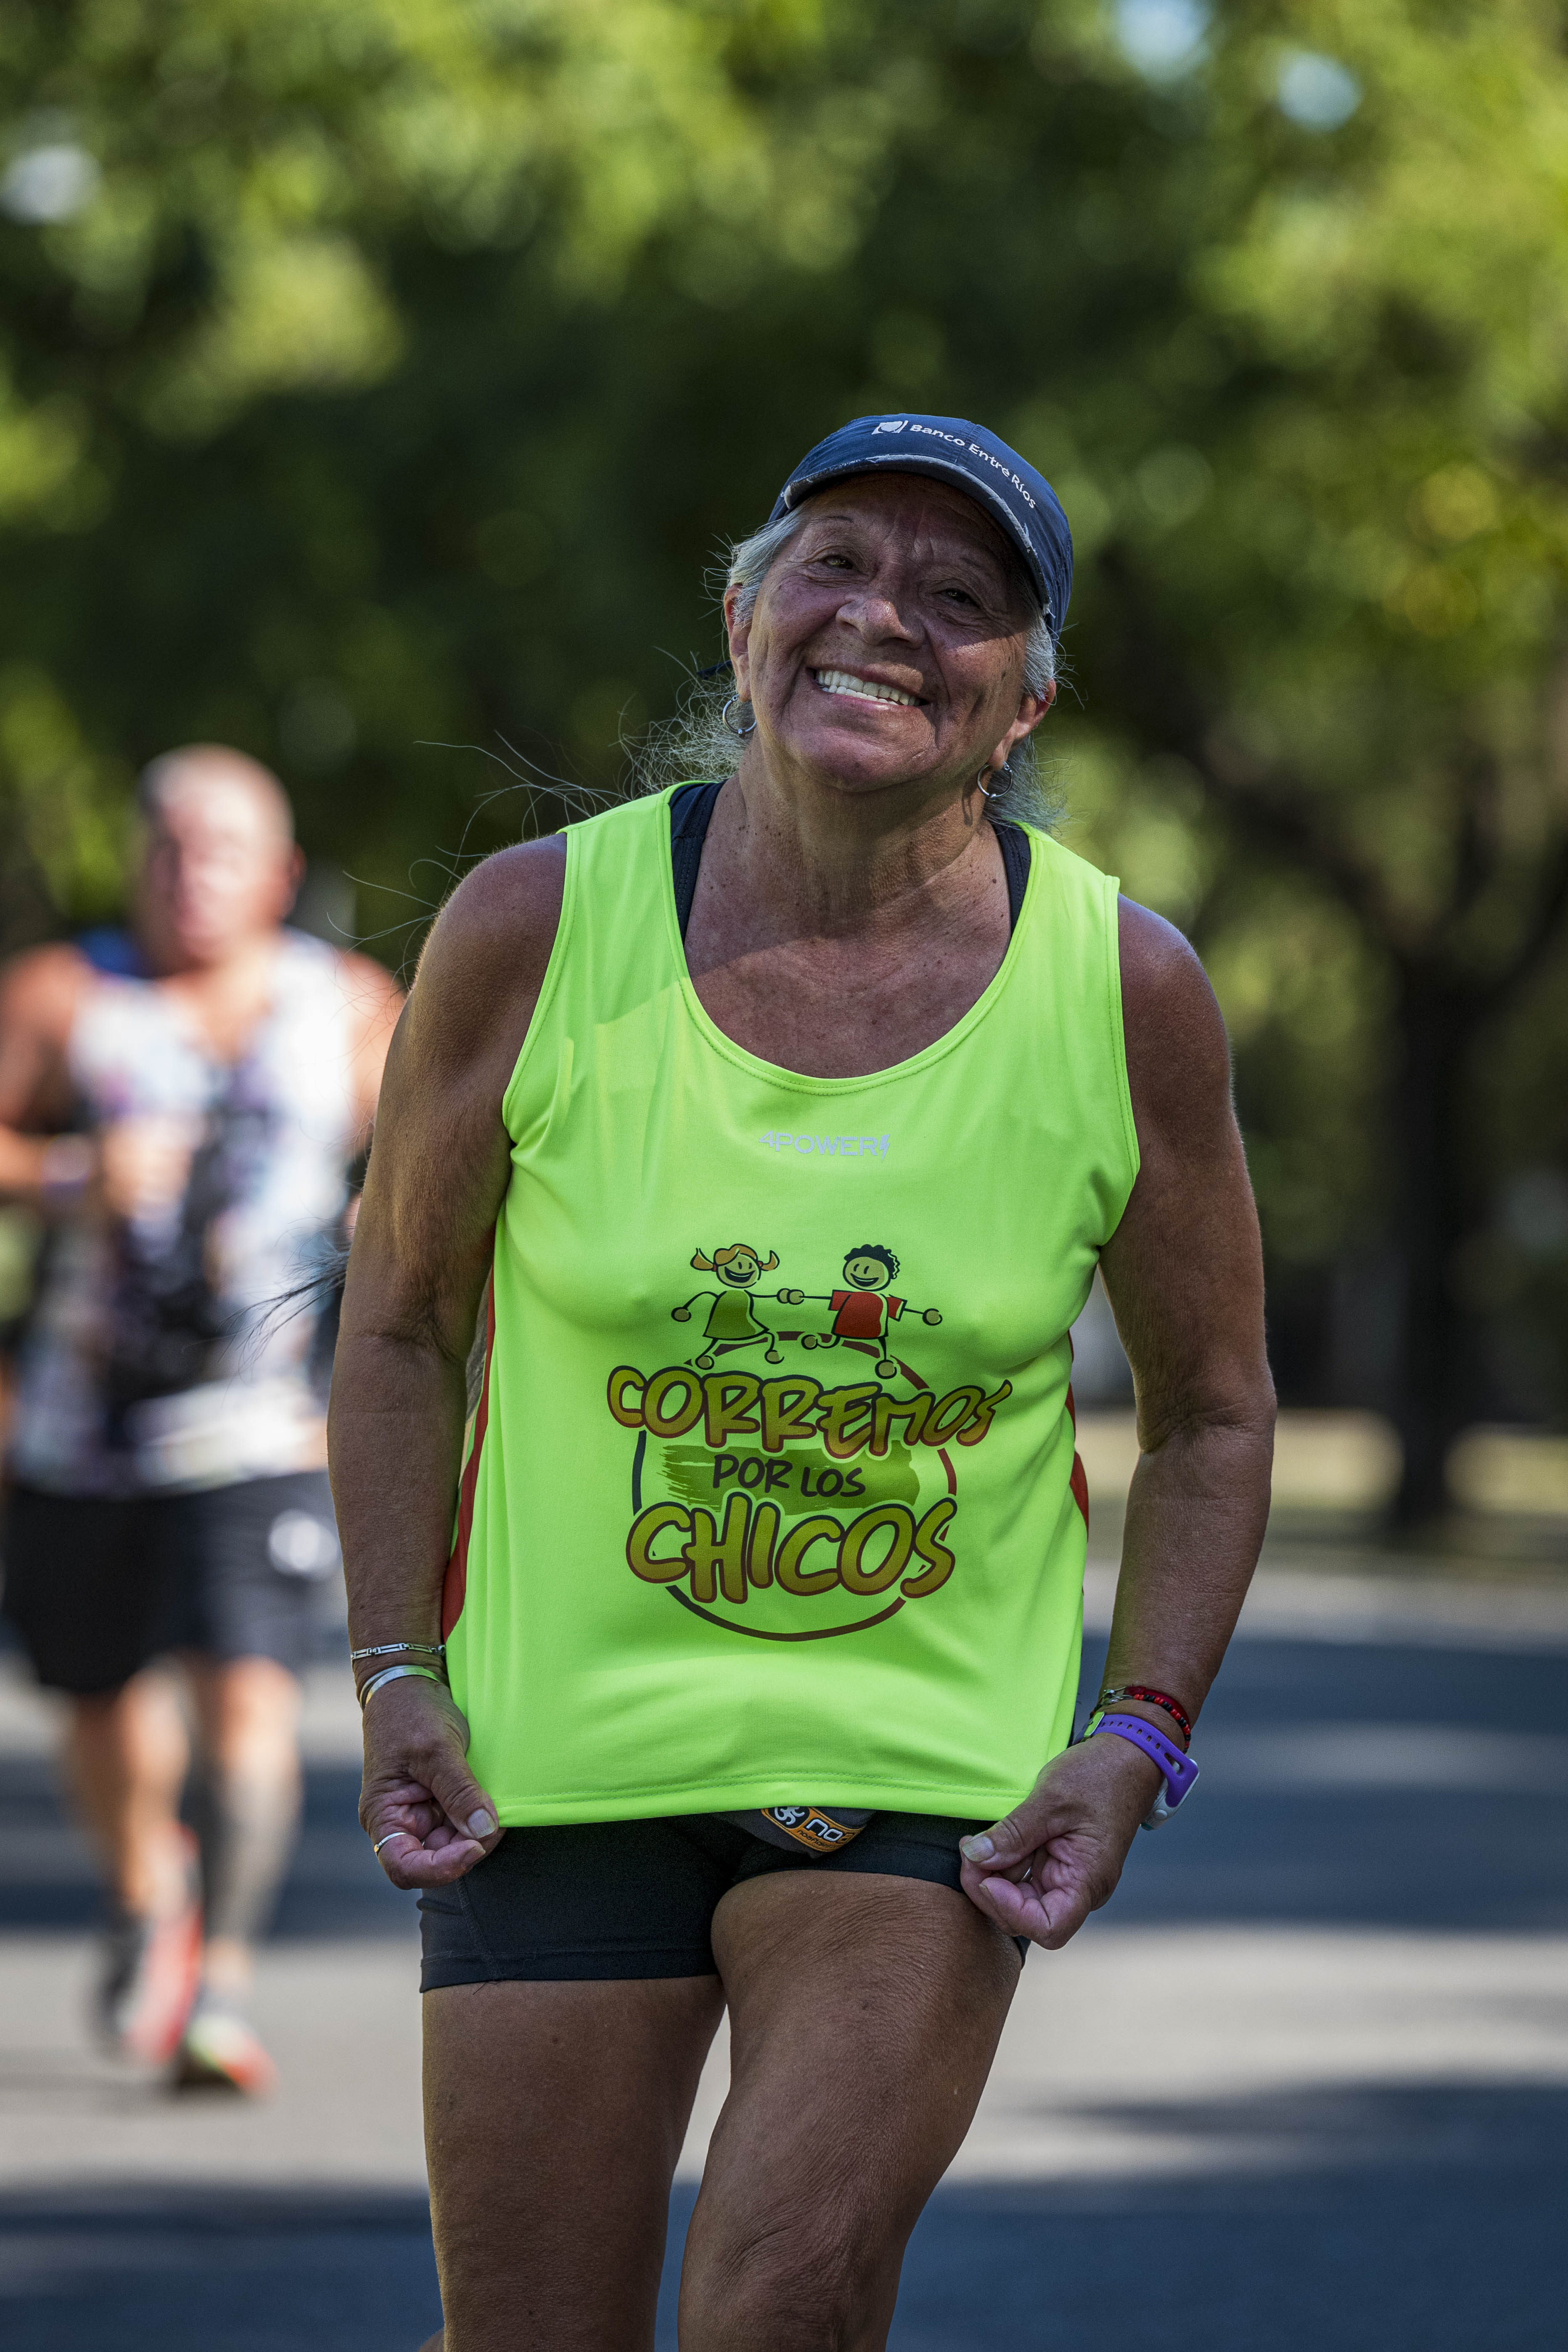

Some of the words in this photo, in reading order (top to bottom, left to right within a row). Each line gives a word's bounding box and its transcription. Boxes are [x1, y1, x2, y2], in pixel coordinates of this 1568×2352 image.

[910, 425, 965, 446] Banco
[968, 443, 1010, 477] Entre
[1011, 474, 1037, 508] Ríos
[607, 1365, 1013, 1459] CORREMOS
[712, 1454, 792, 1492] POR
[800, 1467, 867, 1497] LOS
[625, 1491, 957, 1604] CHICOS
